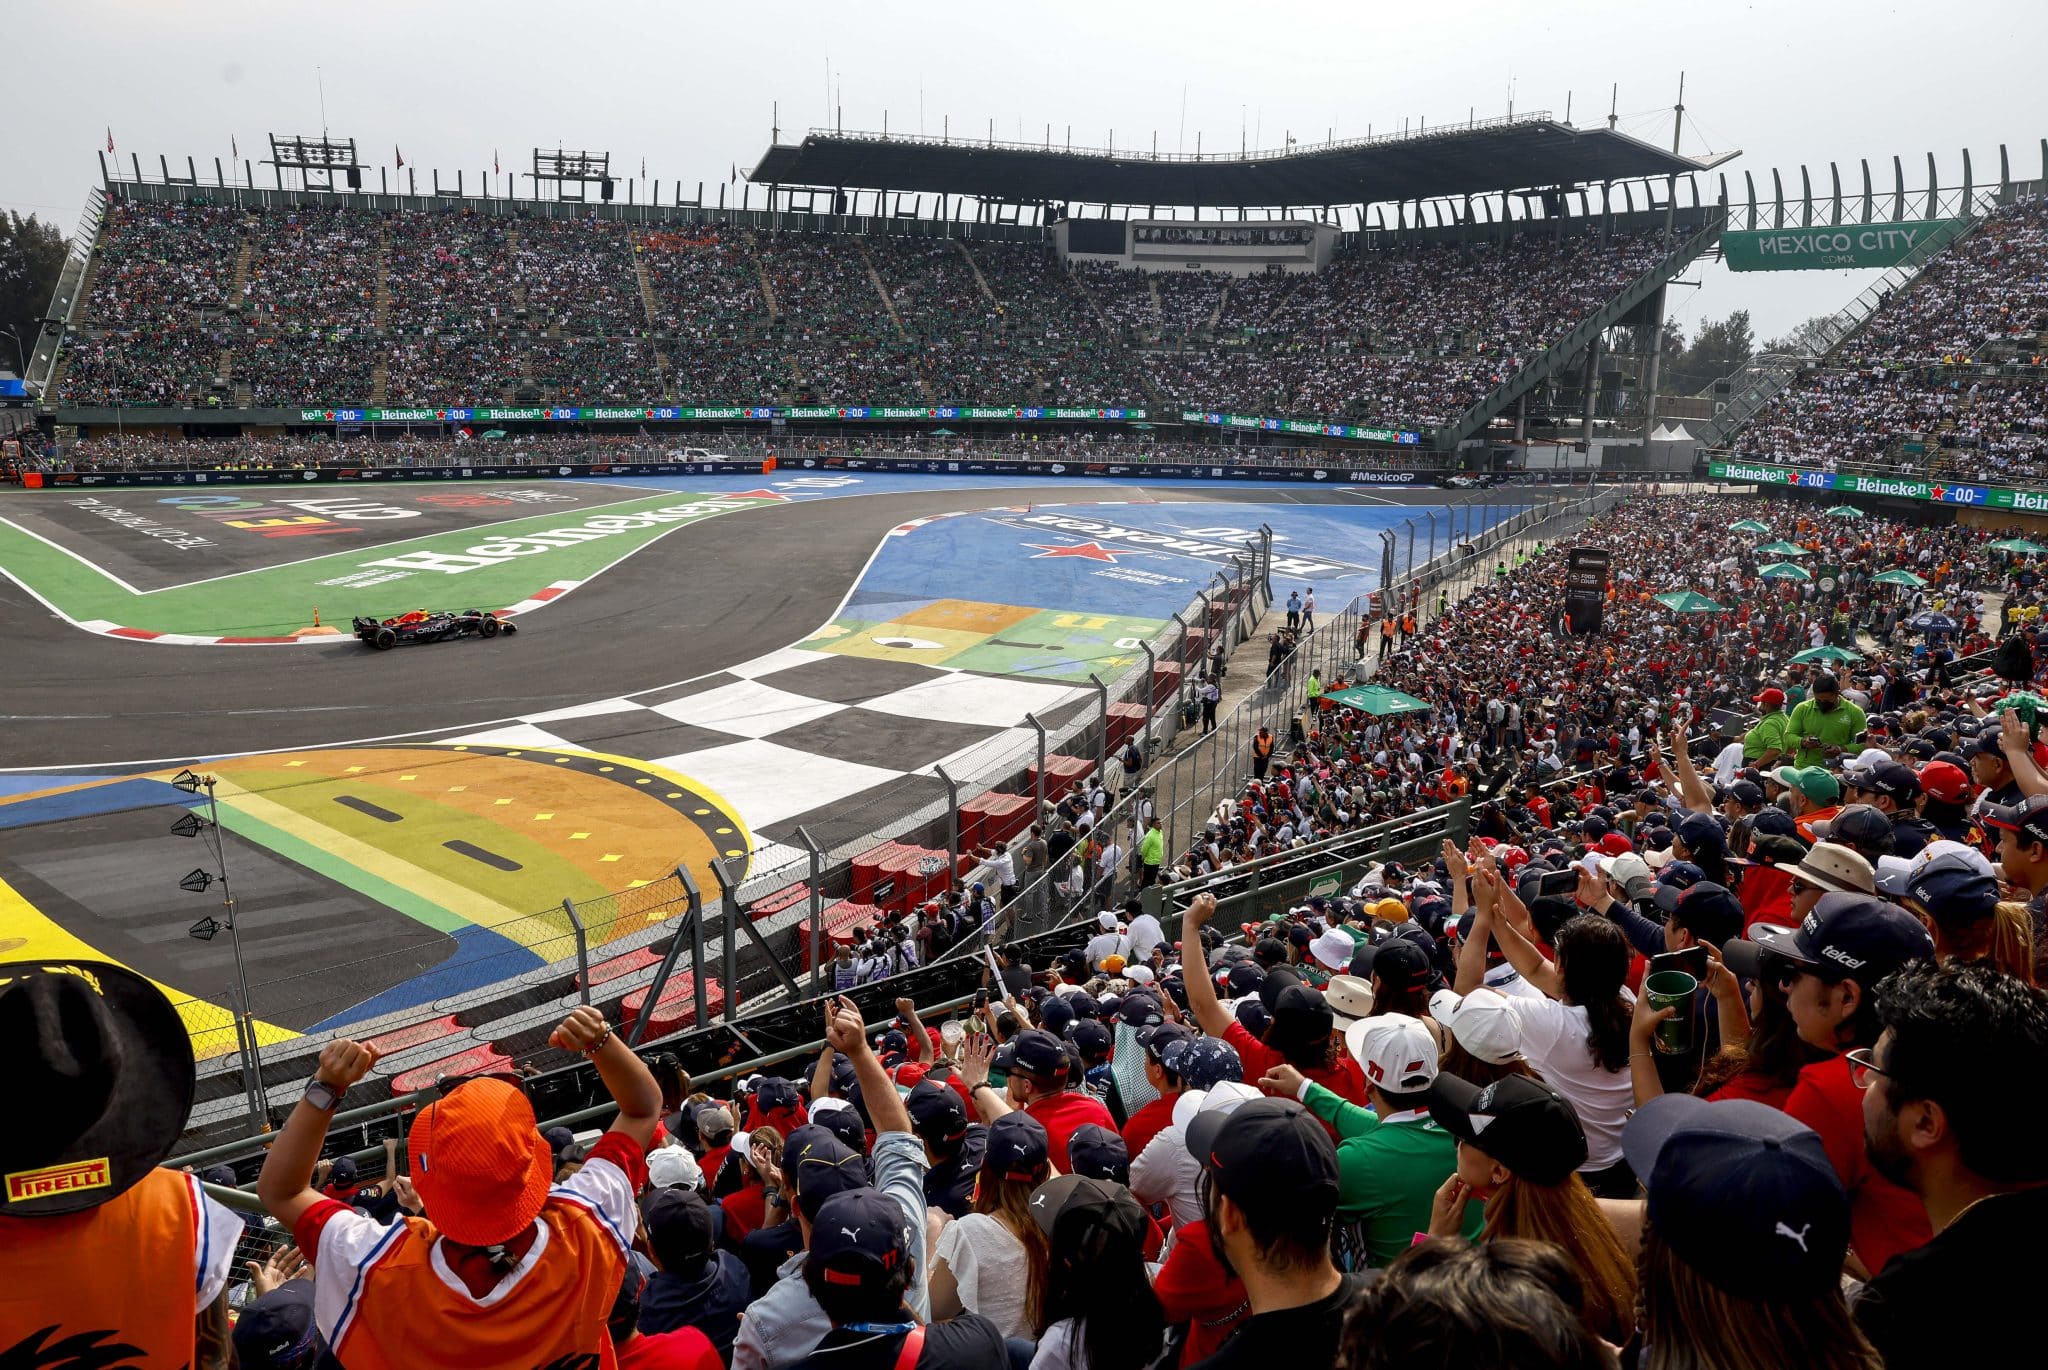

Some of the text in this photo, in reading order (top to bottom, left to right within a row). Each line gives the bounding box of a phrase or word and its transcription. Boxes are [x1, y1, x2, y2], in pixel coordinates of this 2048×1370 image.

[1759, 229, 1918, 256] MEXICO CITY
[1821, 255, 1856, 265] CDMX
[382, 409, 434, 420] Heineken
[490, 409, 540, 419] Heineken
[559, 409, 571, 419] 0.0
[595, 408, 643, 419] Heineken
[660, 409, 672, 418] 0.0
[695, 408, 741, 418] Heineken
[792, 408, 836, 418] Heineken
[852, 408, 863, 418] 0.0
[884, 407, 926, 418] Heineken
[942, 408, 952, 418] 0.0
[972, 408, 1013, 418] Heineken
[1027, 409, 1038, 418] 0.0
[1057, 408, 1096, 418] Heineken
[1231, 416, 1260, 427] Heineken
[1291, 422, 1322, 433] Heineken
[1357, 429, 1391, 441] Heineken
[1350, 472, 1415, 483] #MexicoGP
[1725, 465, 1785, 482] Heineken
[1808, 473, 1824, 487] 0.0
[1856, 477, 1926, 497] Heineken
[1955, 488, 1974, 503] 0.0
[155, 495, 365, 539] MEXICO
[270, 497, 424, 521] CITY
[358, 501, 757, 574] Heineken
[416, 624, 451, 634] ORACLE
[1915, 886, 1932, 903] telcel
[1821, 944, 1867, 970] telcel
[1368, 1060, 1385, 1083] 11
[9, 1162, 104, 1197] PIRELLI
[881, 1249, 897, 1271] 11
